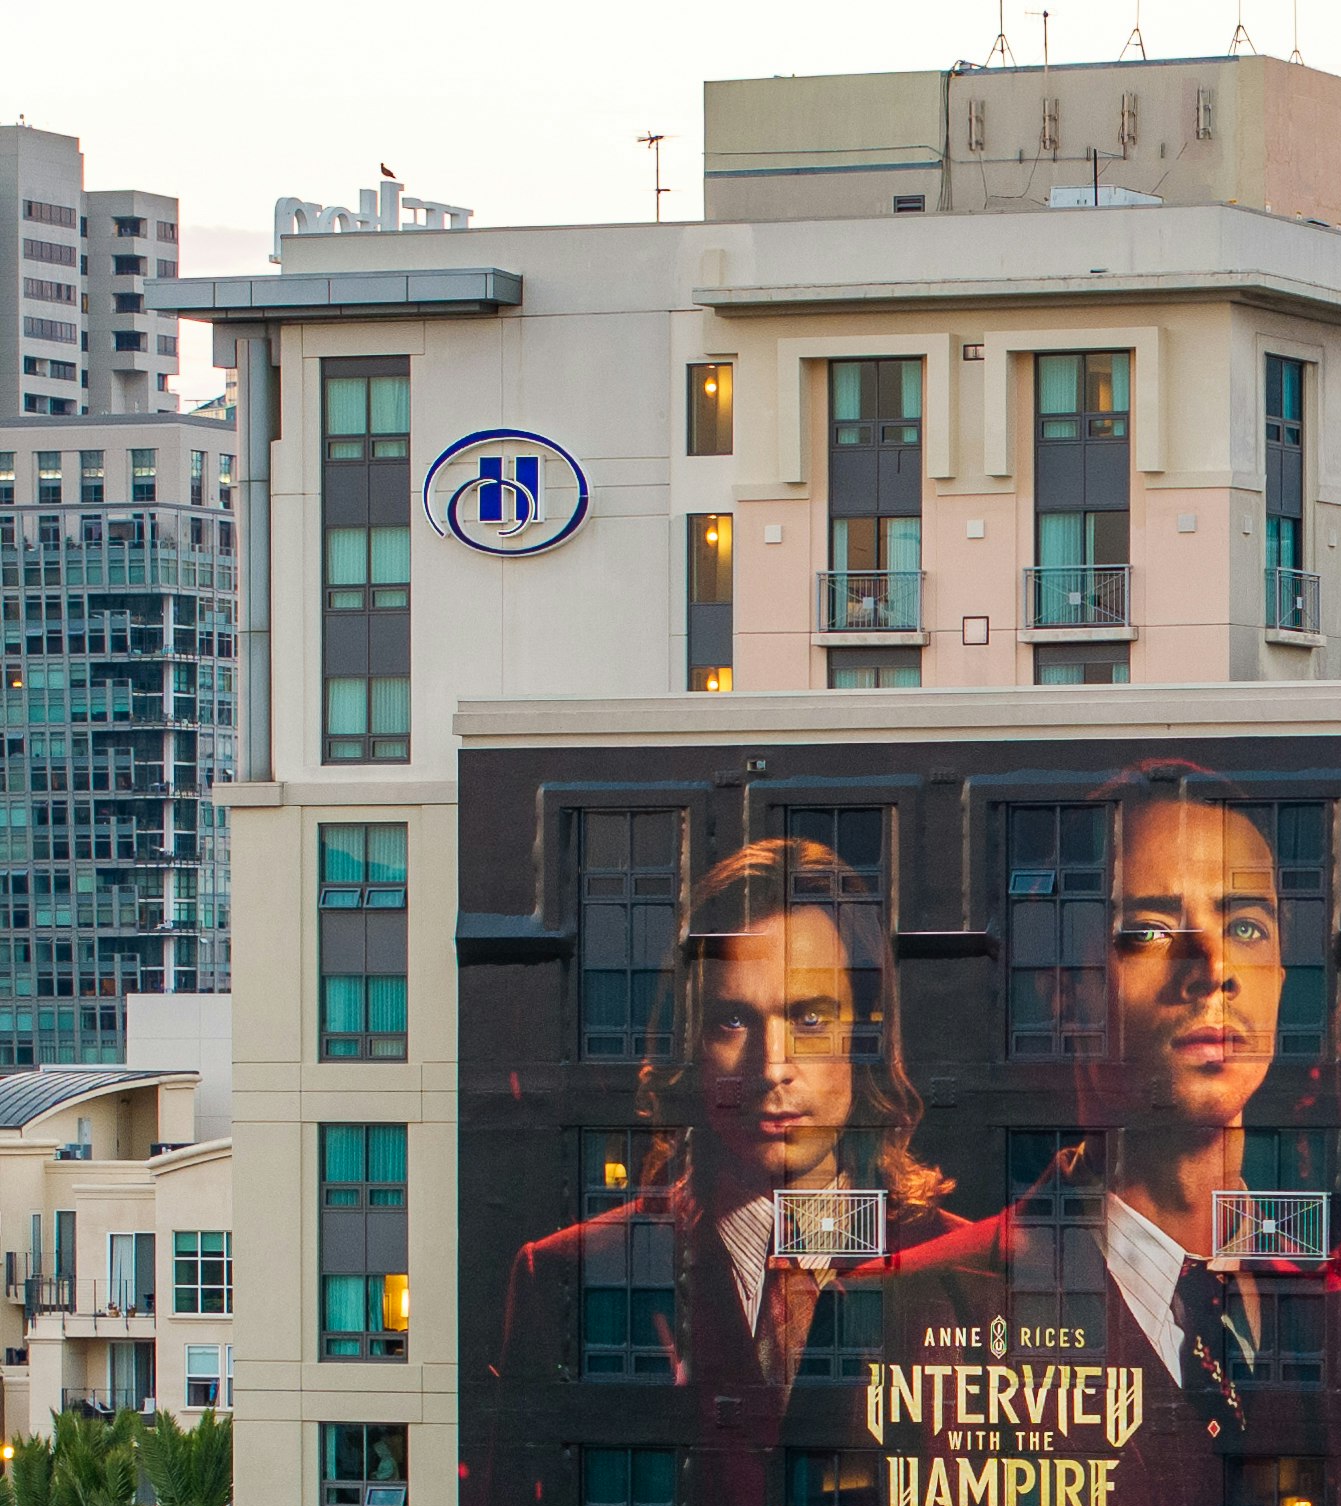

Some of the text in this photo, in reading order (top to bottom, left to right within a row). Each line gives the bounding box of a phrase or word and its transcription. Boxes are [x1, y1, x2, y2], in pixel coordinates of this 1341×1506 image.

[924, 1327, 1086, 1348] ANNE RICE'S
[867, 1363, 1143, 1447] INTERVIEW
[948, 1431, 1054, 1451] WITH THE
